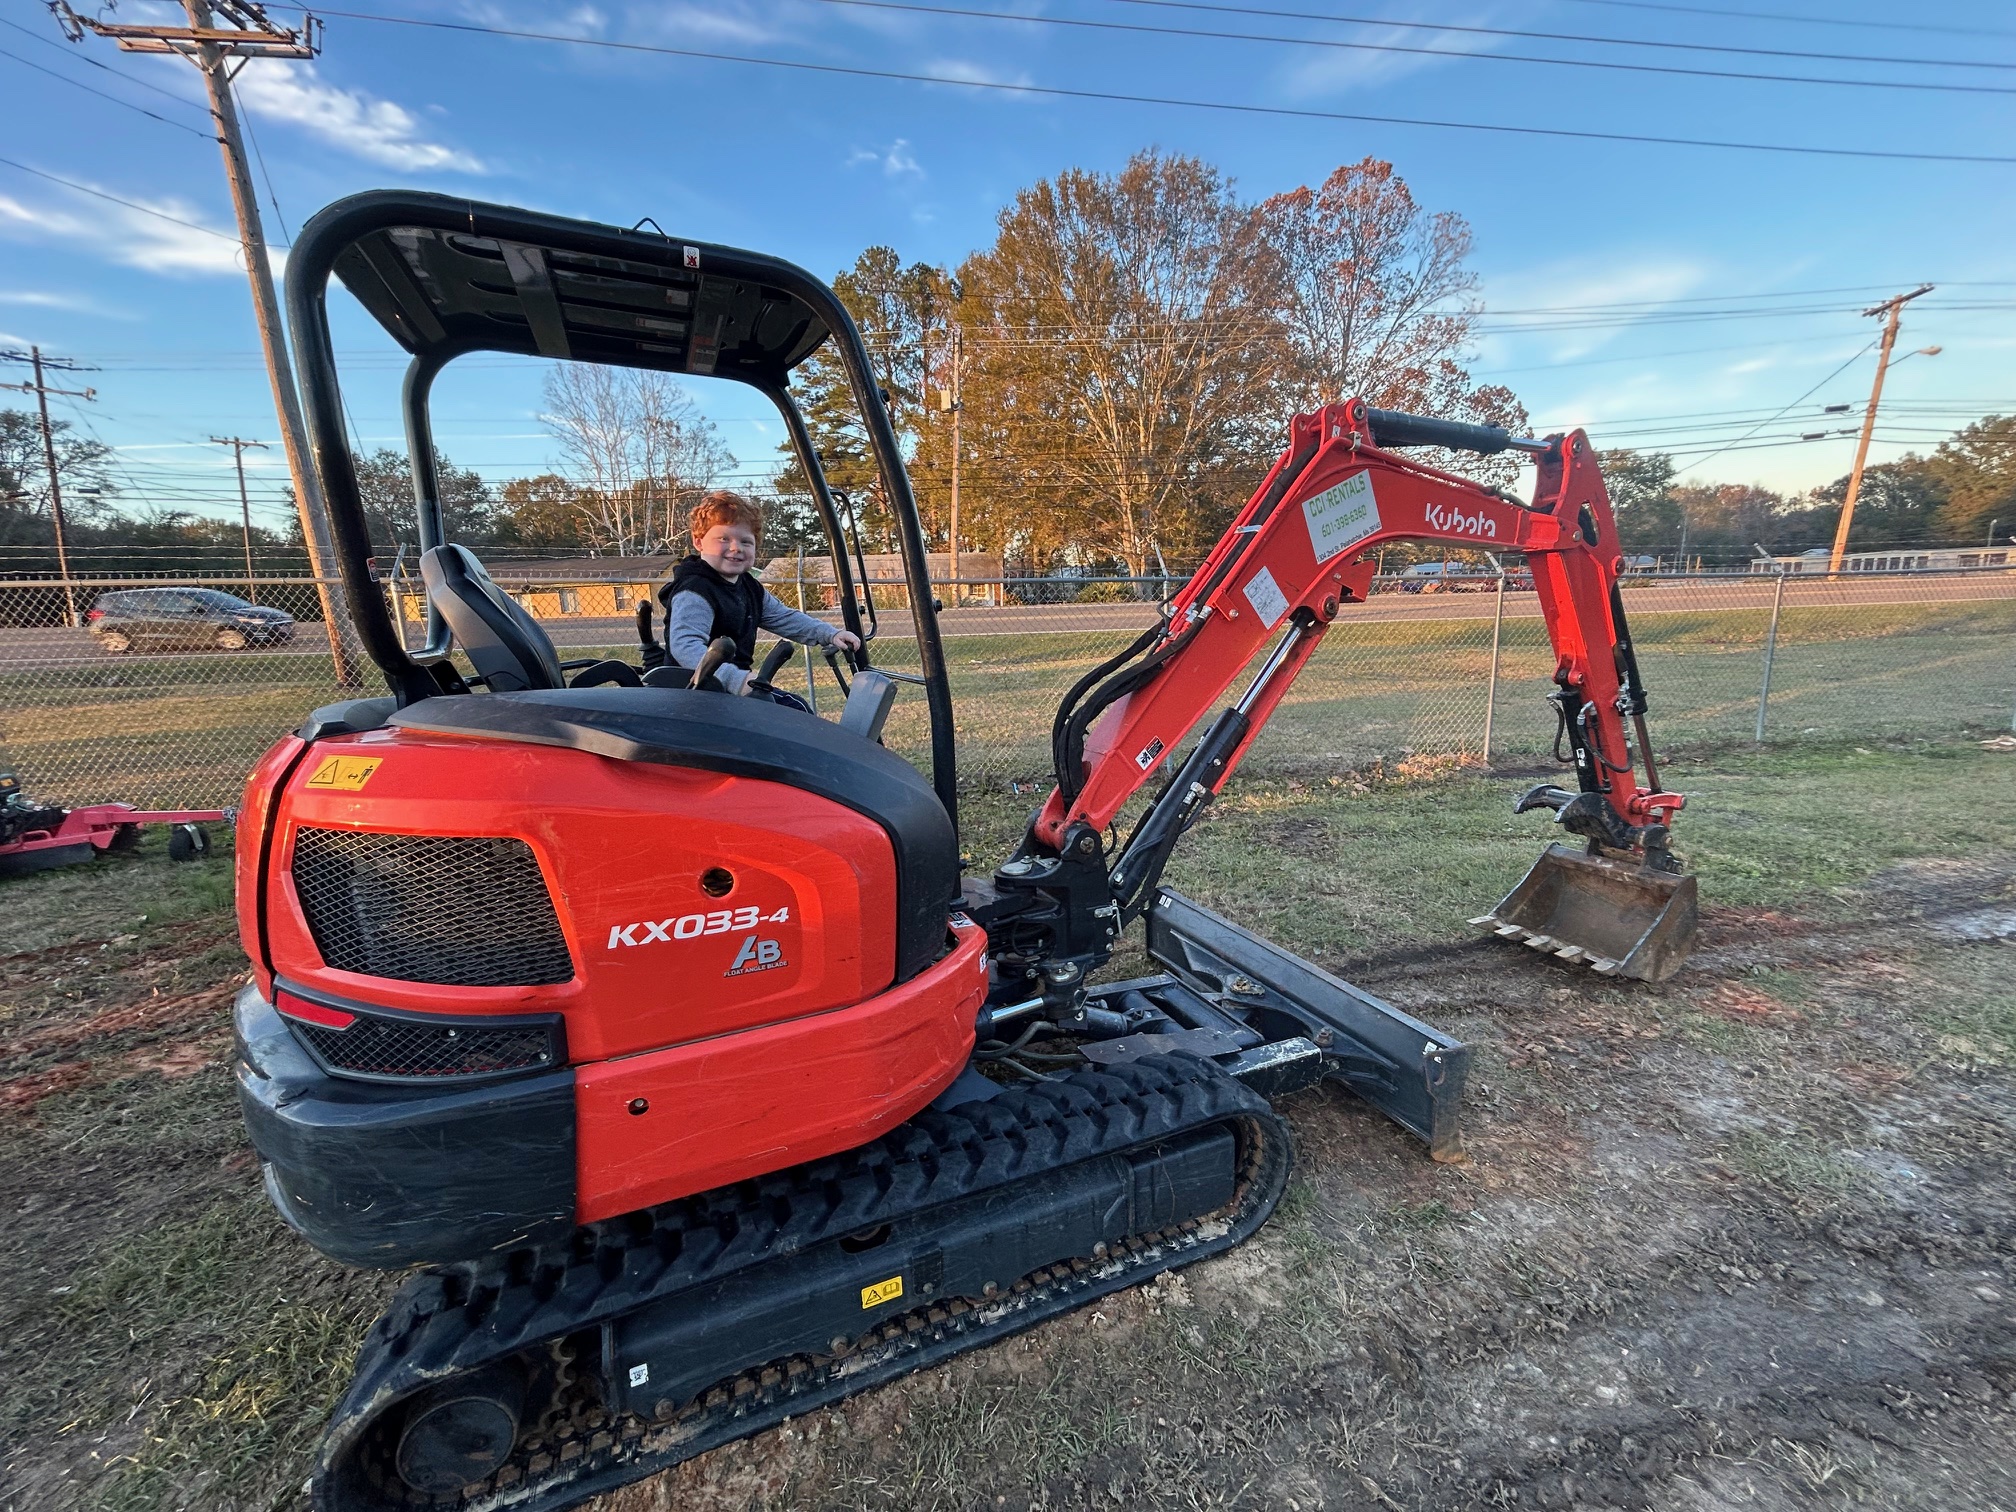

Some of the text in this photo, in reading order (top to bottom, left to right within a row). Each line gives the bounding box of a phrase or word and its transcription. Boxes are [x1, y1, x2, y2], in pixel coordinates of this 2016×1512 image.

[1309, 474, 1366, 518] CCI RENTALS
[1425, 502, 1496, 538] Kubota
[607, 905, 789, 950] KX033-4
[723, 961, 788, 978] FLOAT ANGLE BLADE
